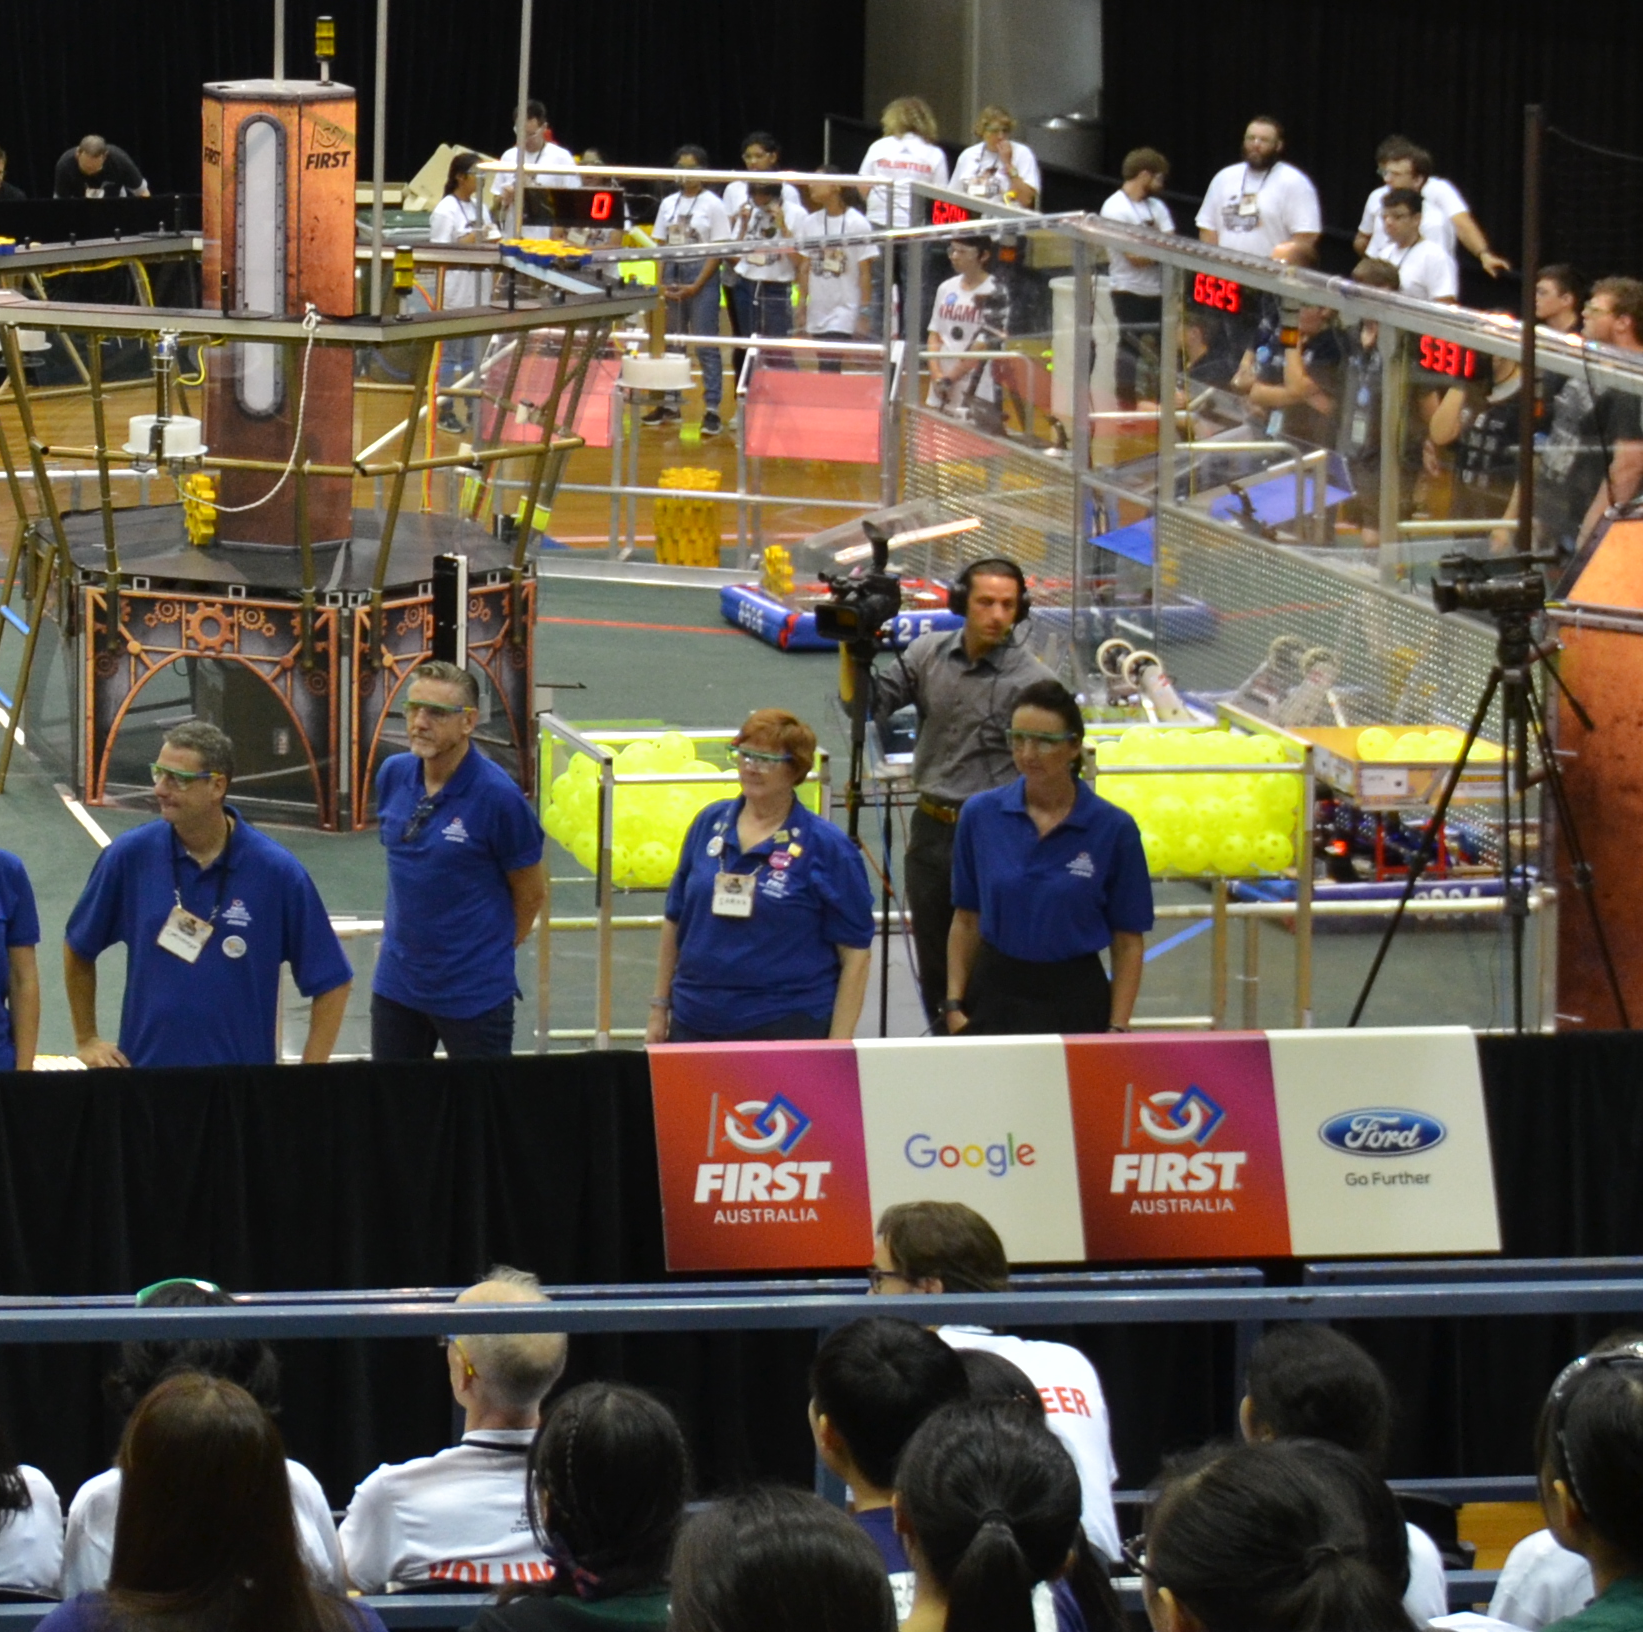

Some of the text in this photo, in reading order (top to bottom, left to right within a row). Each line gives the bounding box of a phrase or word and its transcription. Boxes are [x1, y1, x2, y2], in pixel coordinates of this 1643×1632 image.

[305, 150, 351, 171] FIRST
[1193, 272, 1241, 314] 6525
[1420, 334, 1475, 379] 5331
[1343, 1115, 1424, 1149] Ford
[904, 1131, 1036, 1178] Google
[1110, 1151, 1247, 1194] FIRST
[693, 1161, 832, 1204] FIRST
[1344, 1171, 1431, 1187] Go Further
[713, 1207, 819, 1225] AUSTRALIA
[1129, 1197, 1235, 1215] AUSTRALIA
